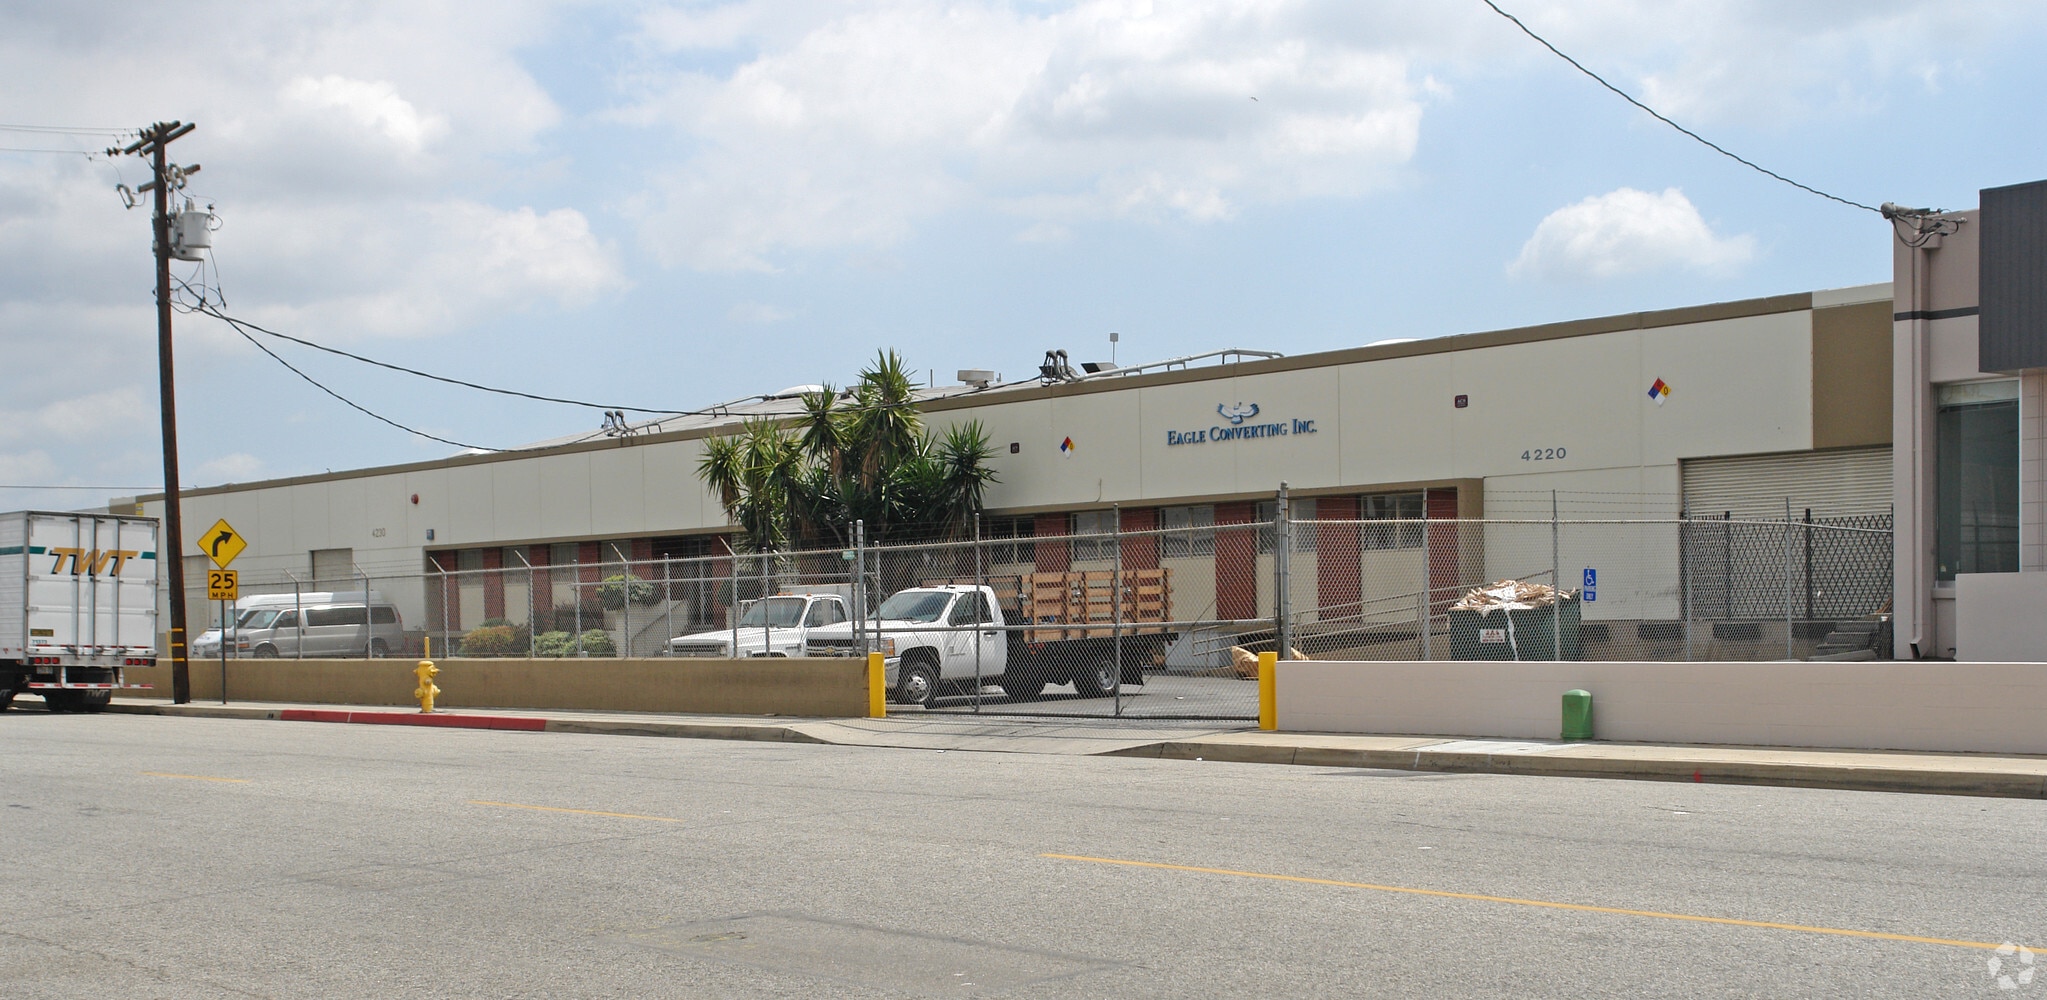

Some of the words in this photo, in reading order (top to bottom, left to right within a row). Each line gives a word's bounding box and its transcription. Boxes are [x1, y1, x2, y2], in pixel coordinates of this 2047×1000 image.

[1166, 430, 1206, 445] EAGLE
[1209, 422, 1288, 442] CONVERTING
[1292, 418, 1318, 434] INC.
[1520, 447, 1566, 462] 4220
[48, 547, 138, 577] TWT
[211, 573, 234, 589] 25
[86, 690, 110, 698] TWT
